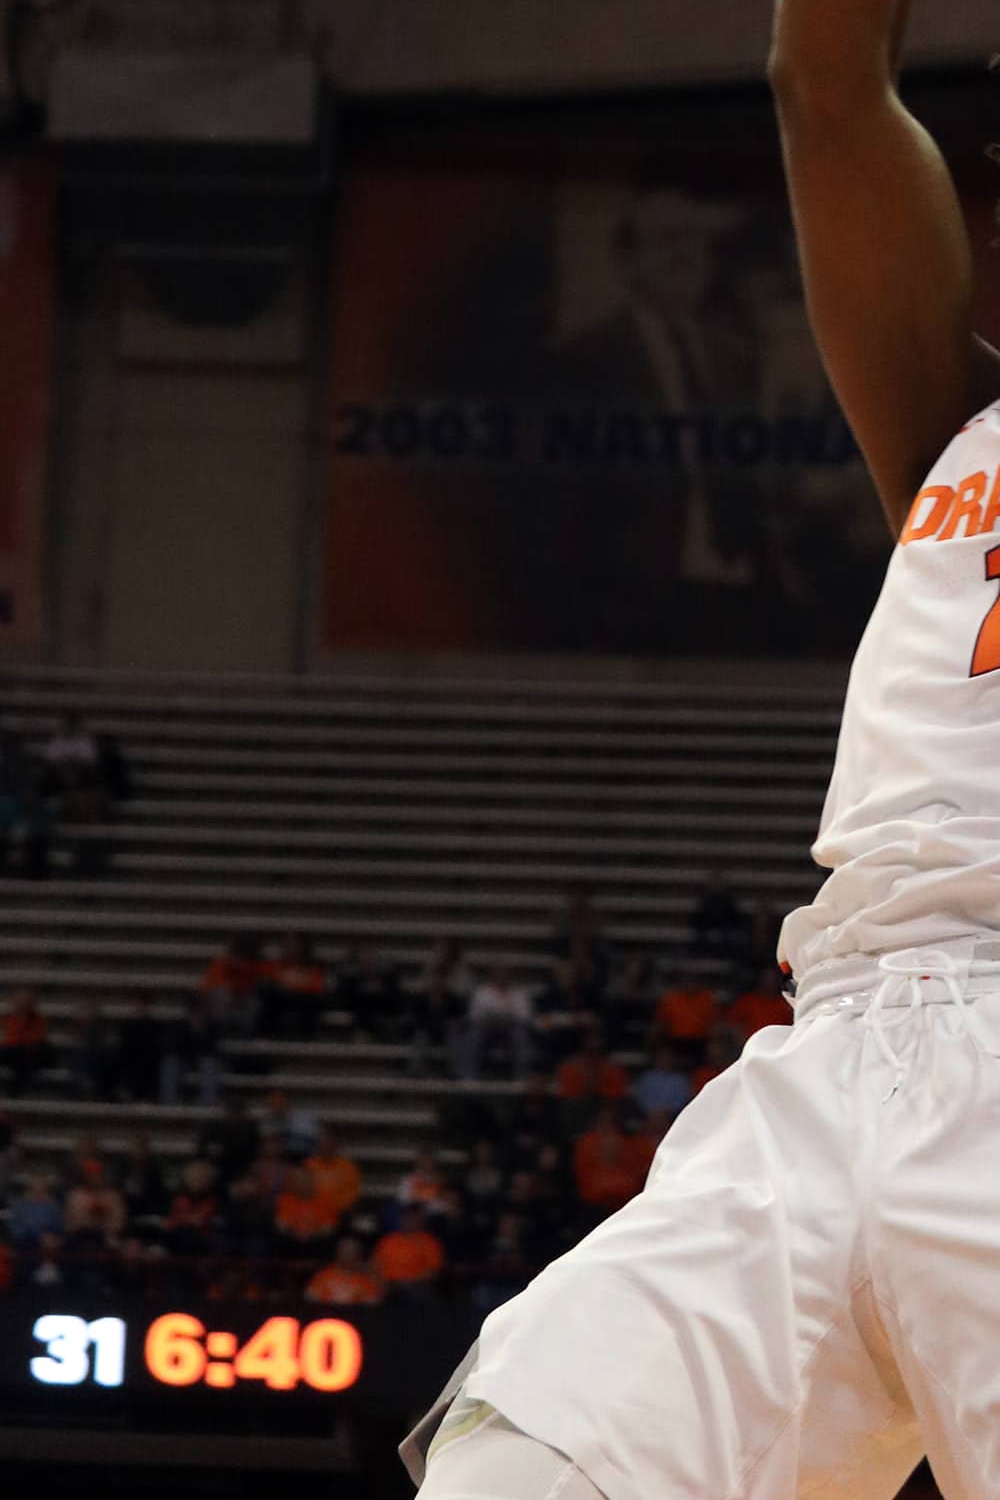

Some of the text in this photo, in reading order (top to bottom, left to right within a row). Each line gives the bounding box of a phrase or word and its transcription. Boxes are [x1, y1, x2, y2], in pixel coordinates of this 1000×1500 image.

[336, 401, 514, 457] 2003
[30, 1312, 363, 1392] 31 6:40
